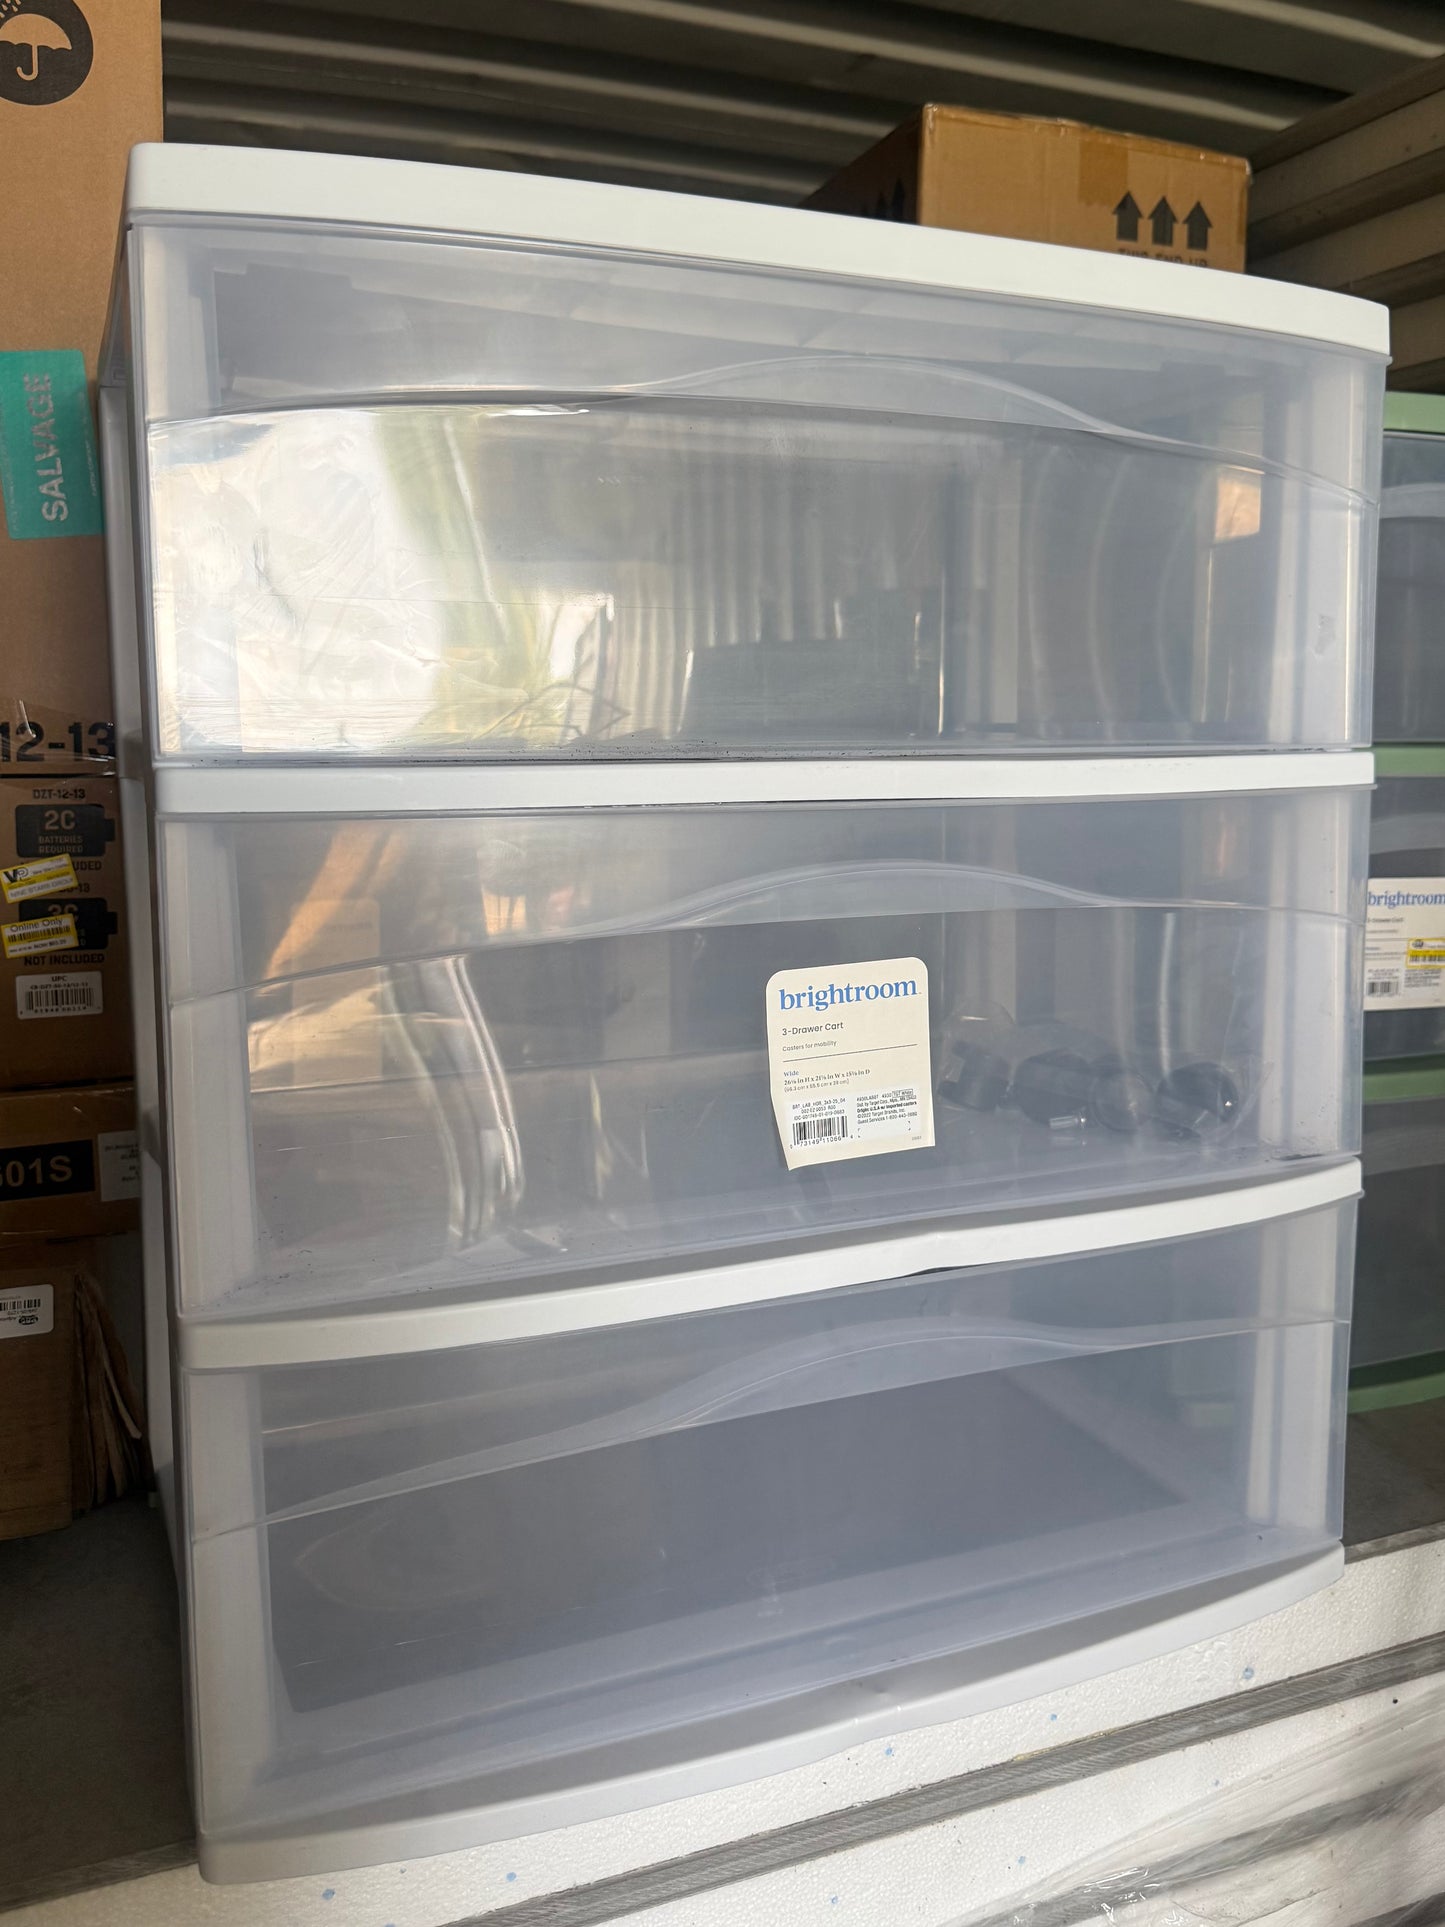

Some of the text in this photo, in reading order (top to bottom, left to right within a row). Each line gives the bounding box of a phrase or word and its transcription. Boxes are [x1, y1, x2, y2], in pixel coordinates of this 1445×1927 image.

[24, 373, 69, 521] SALVAGE
[33, 788, 86, 800] DZT-12-13
[45, 810, 76, 830] 2C
[39, 835, 83, 844] BATTERIES
[39, 845, 83, 853] REQUIRED
[10, 918, 63, 933] Online Only
[24, 953, 105, 966] NOT INCLUDED
[779, 980, 918, 1011] brightroom
[782, 1022, 844, 1036] 3-Drawer Cart
[782, 1044, 804, 1052] Casters
[813, 1040, 837, 1049] mobility
[783, 1070, 799, 1078] Wide
[800, 1139, 820, 1147] 73149
[0, 1155, 72, 1188] 01S
